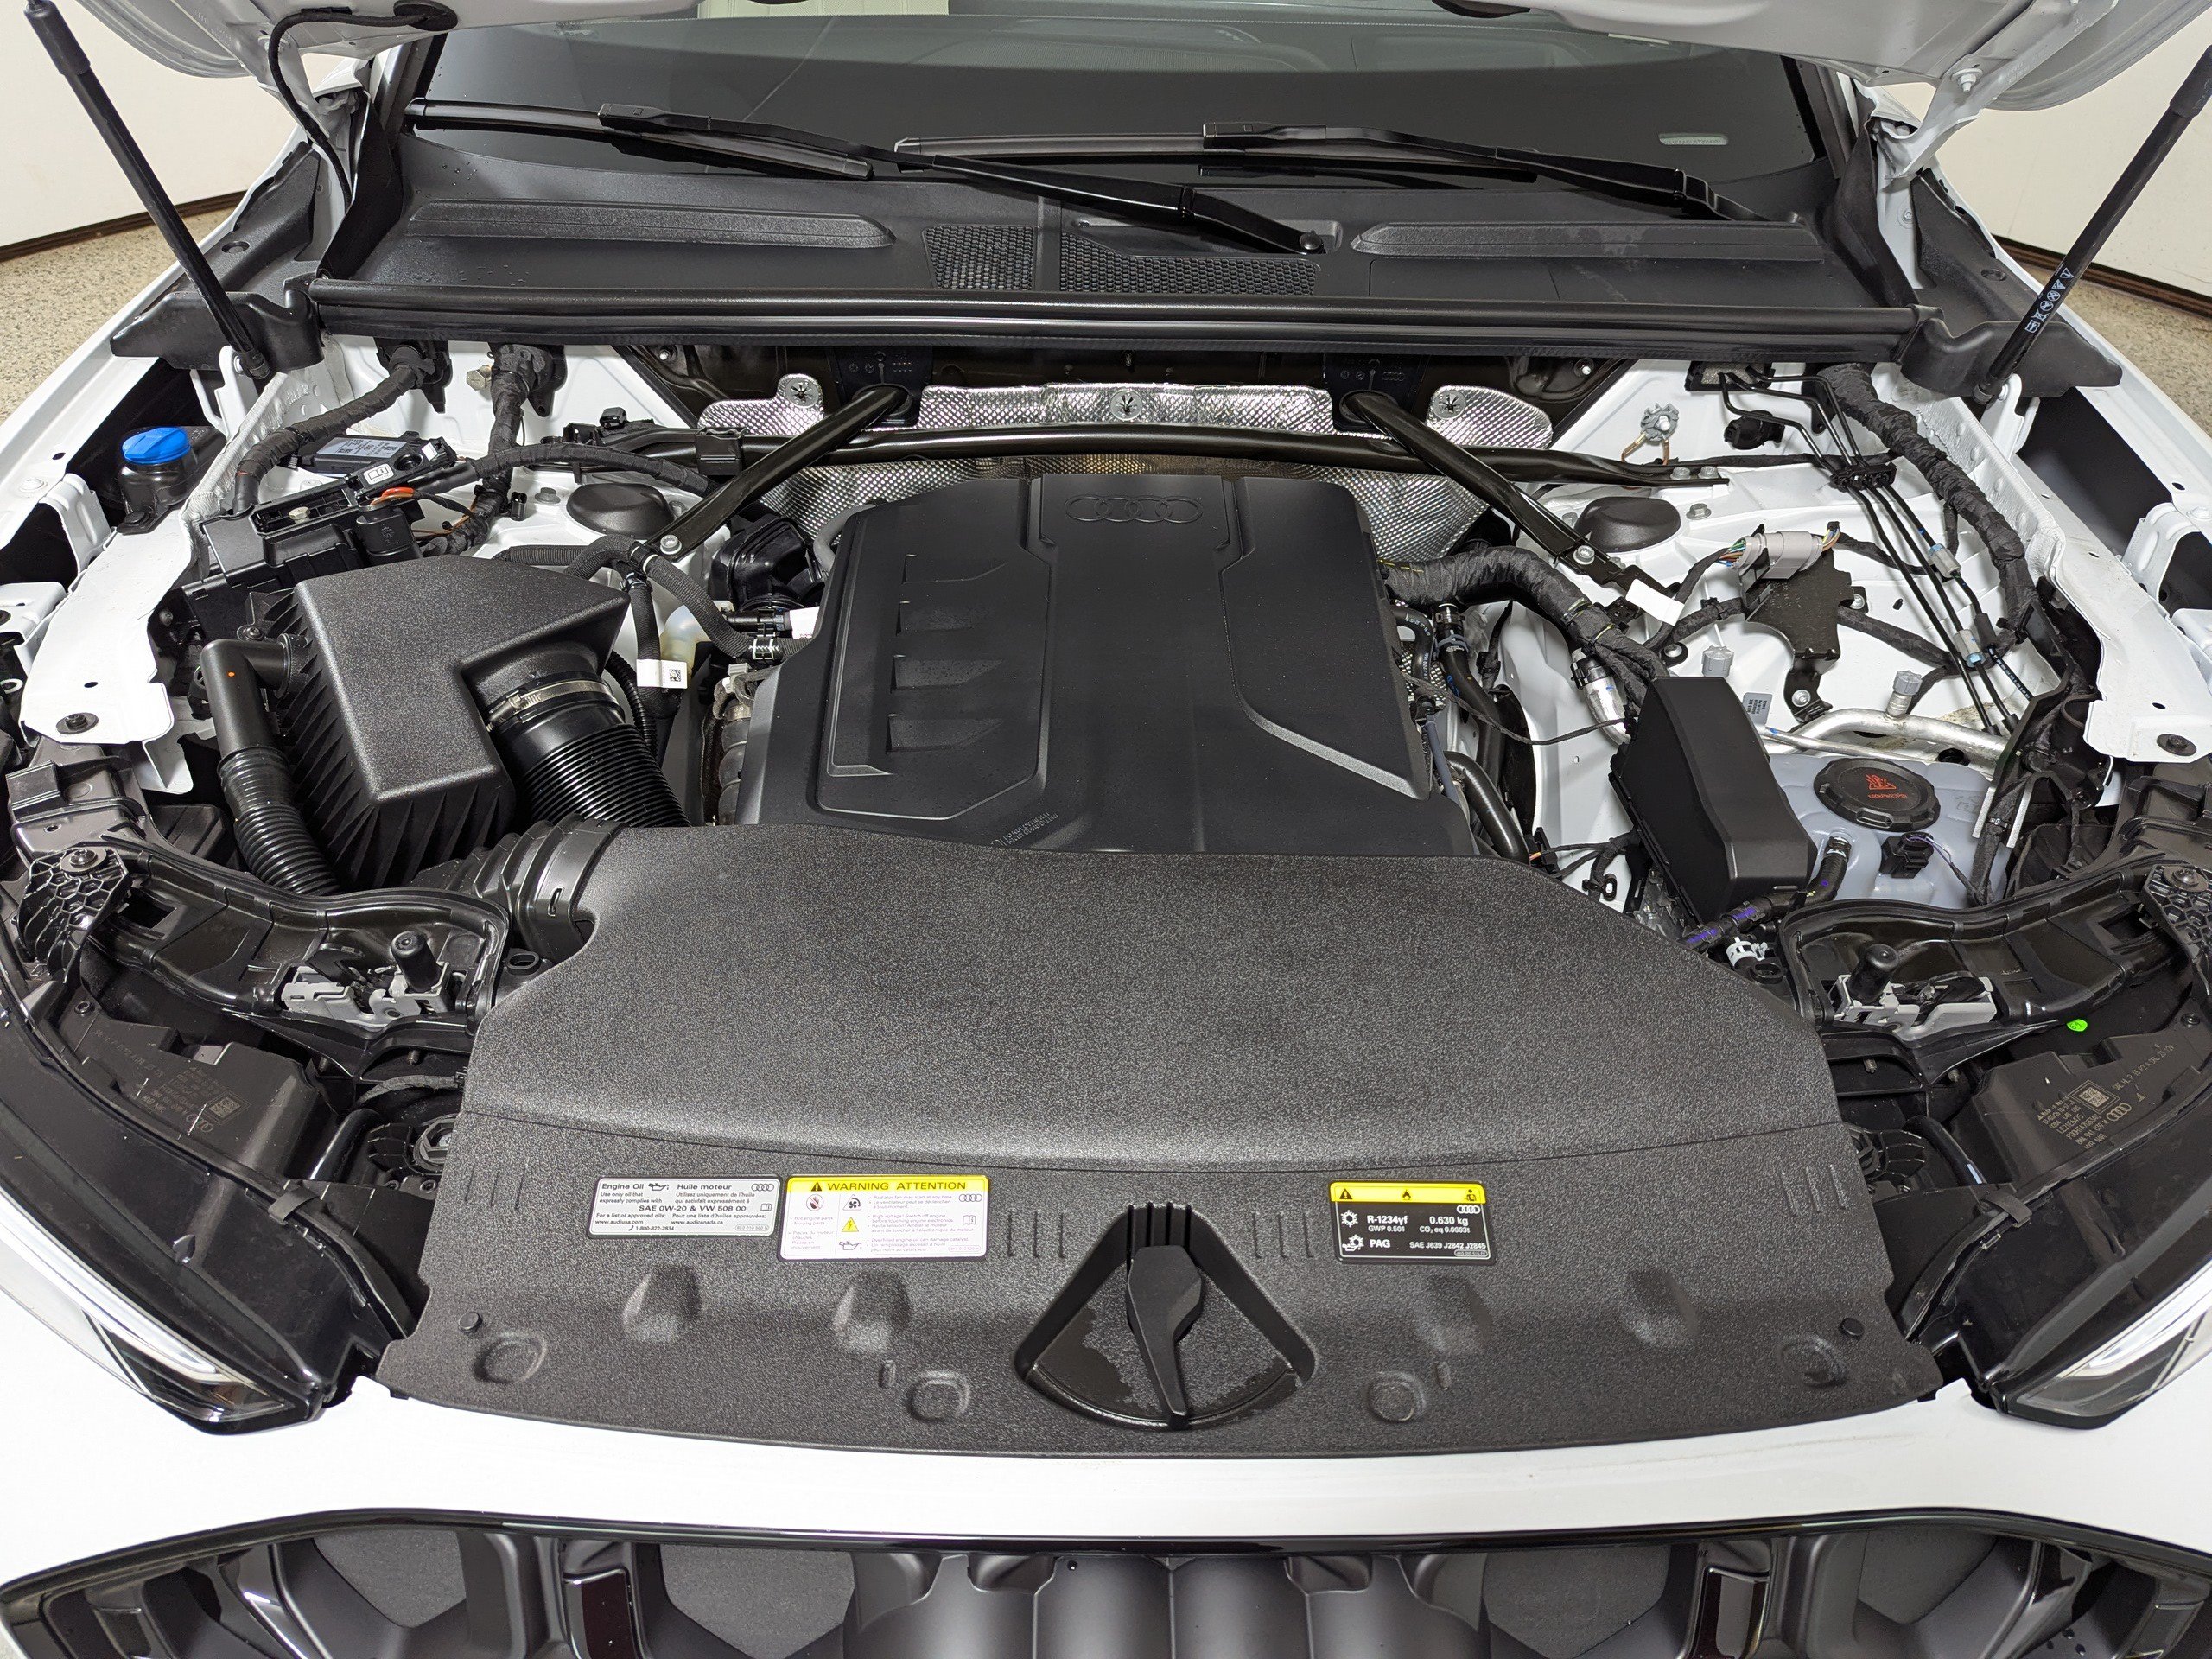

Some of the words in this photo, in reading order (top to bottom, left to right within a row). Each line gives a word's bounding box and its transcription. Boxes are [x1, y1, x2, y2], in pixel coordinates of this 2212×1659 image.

[828, 1182, 889, 1191] WARNING
[1367, 1215, 1408, 1224] R-1234yf
[1429, 1216, 1455, 1225] 0.630
[1457, 1217, 1469, 1227] kg
[1370, 1239, 1390, 1248] PAG
